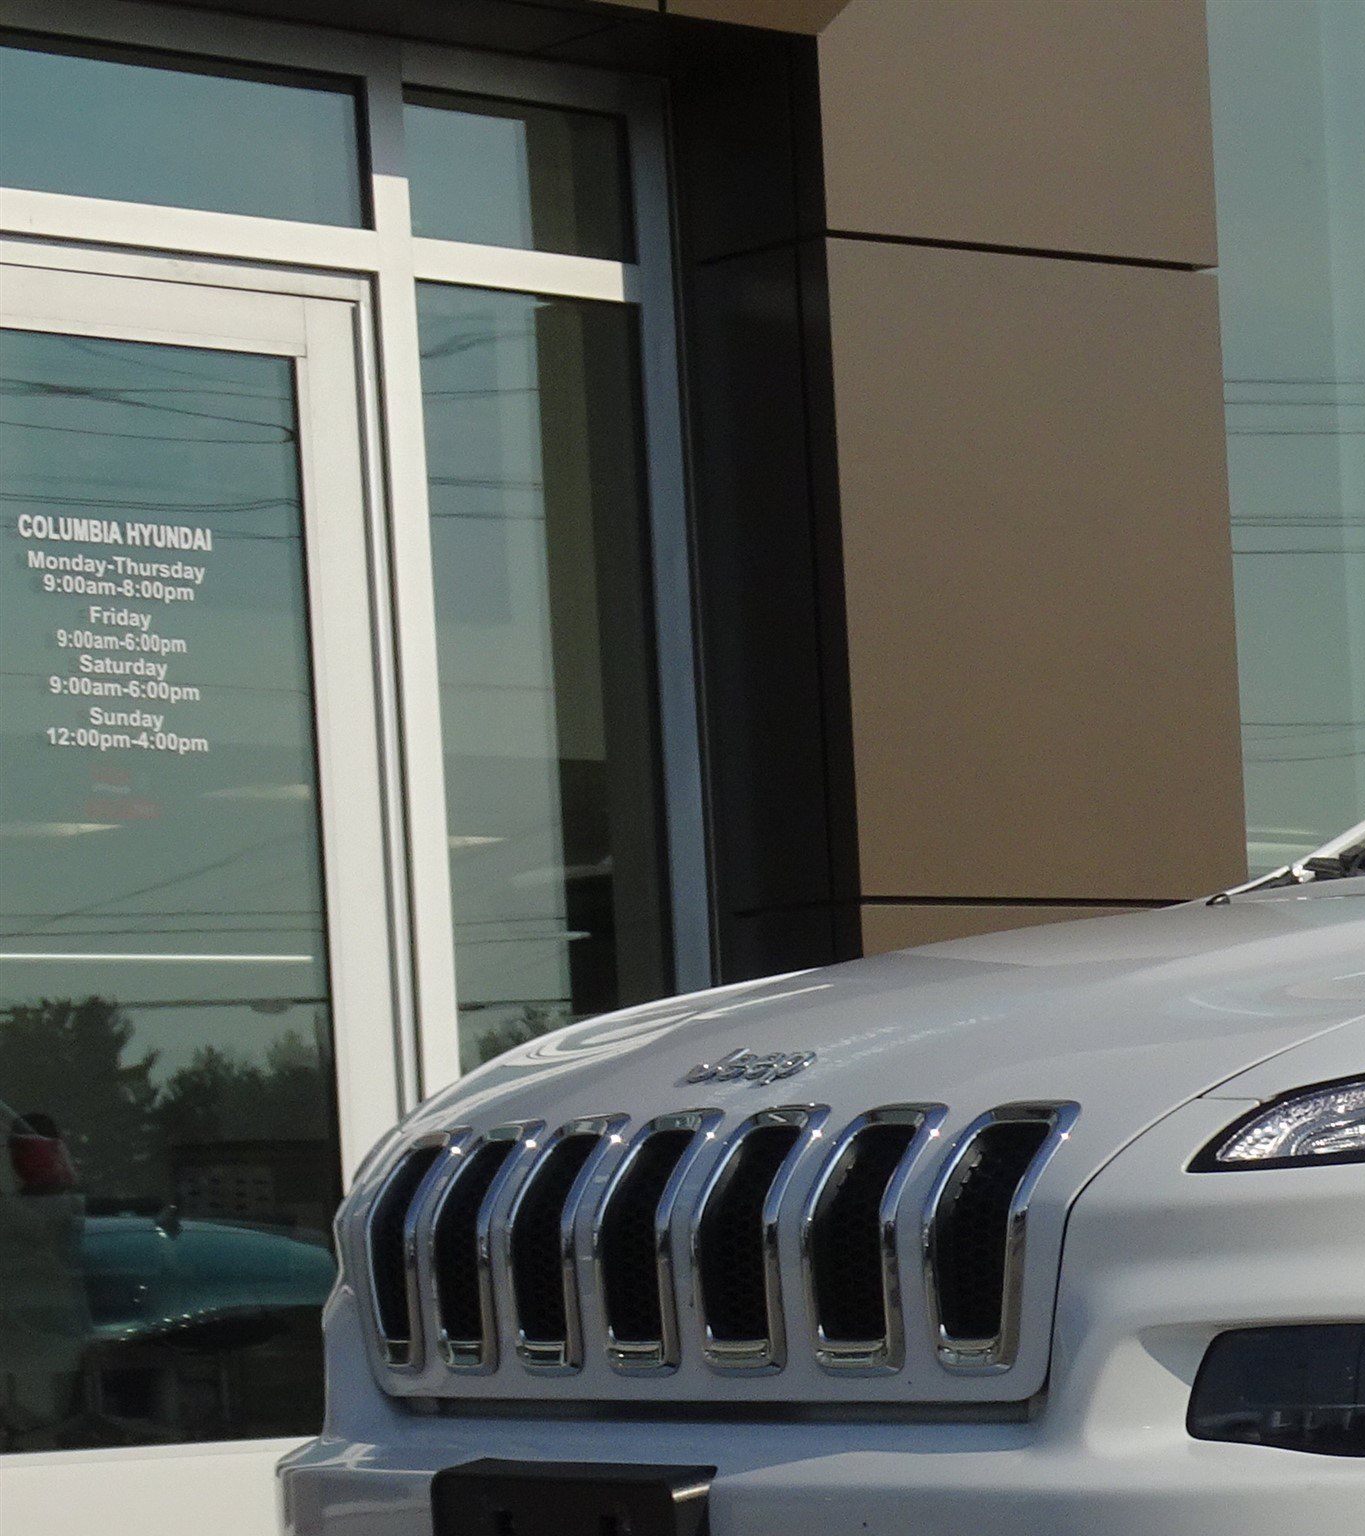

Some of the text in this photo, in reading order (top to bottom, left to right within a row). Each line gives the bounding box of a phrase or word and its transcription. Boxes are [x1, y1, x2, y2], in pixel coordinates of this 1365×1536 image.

[18, 514, 213, 551] COLUMBIA HYUNDAI
[27, 550, 206, 584] Monday-Thursday
[43, 575, 195, 603] 9:00am-8:00pm
[89, 606, 152, 631] Friday
[56, 630, 188, 656] 9:00am-6:00pm
[79, 654, 168, 680] Saturday
[49, 676, 201, 703] 9:00am-6:00pm
[89, 707, 164, 732] Sunday
[46, 727, 209, 755] 12:00pm-4:00pm
[686, 1048, 817, 1086] Jeep
